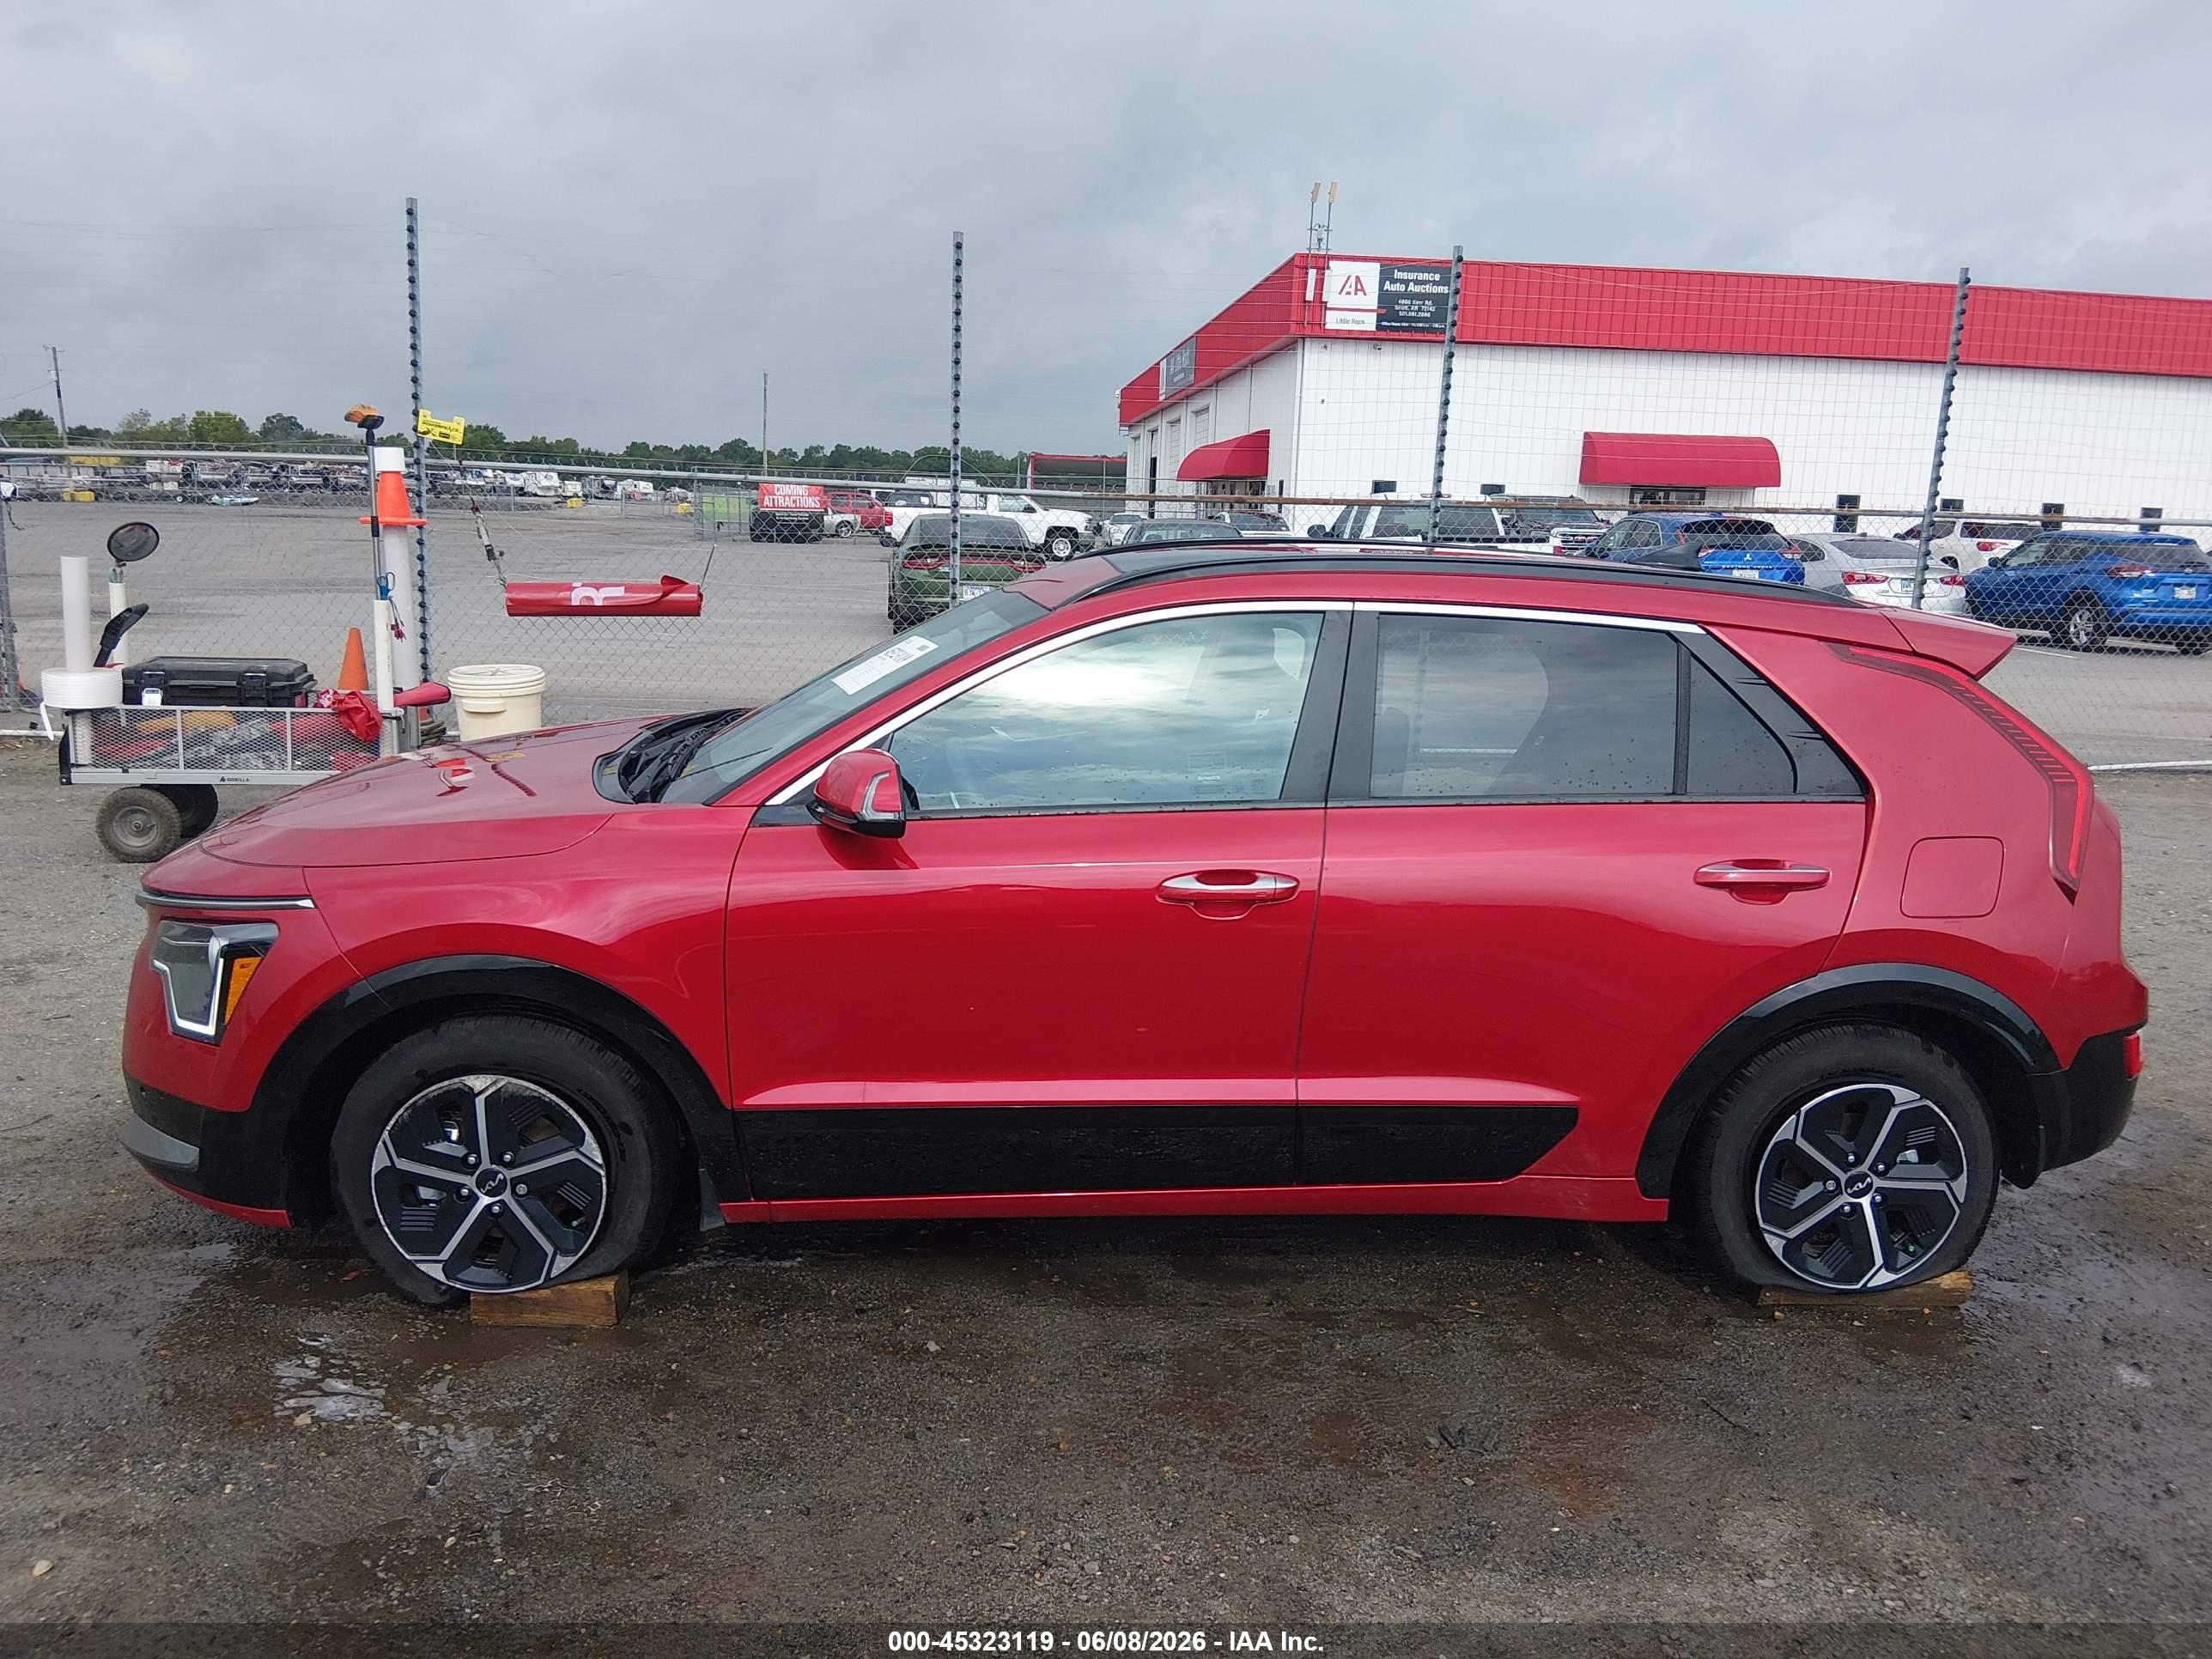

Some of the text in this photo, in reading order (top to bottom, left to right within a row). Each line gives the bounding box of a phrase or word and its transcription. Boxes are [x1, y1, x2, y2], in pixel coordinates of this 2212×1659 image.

[1394, 270, 1440, 281] Insurance
[1383, 281, 1449, 294] Auto Auctions
[775, 484, 809, 495] COMING
[763, 495, 820, 507] ATTRACTIONS
